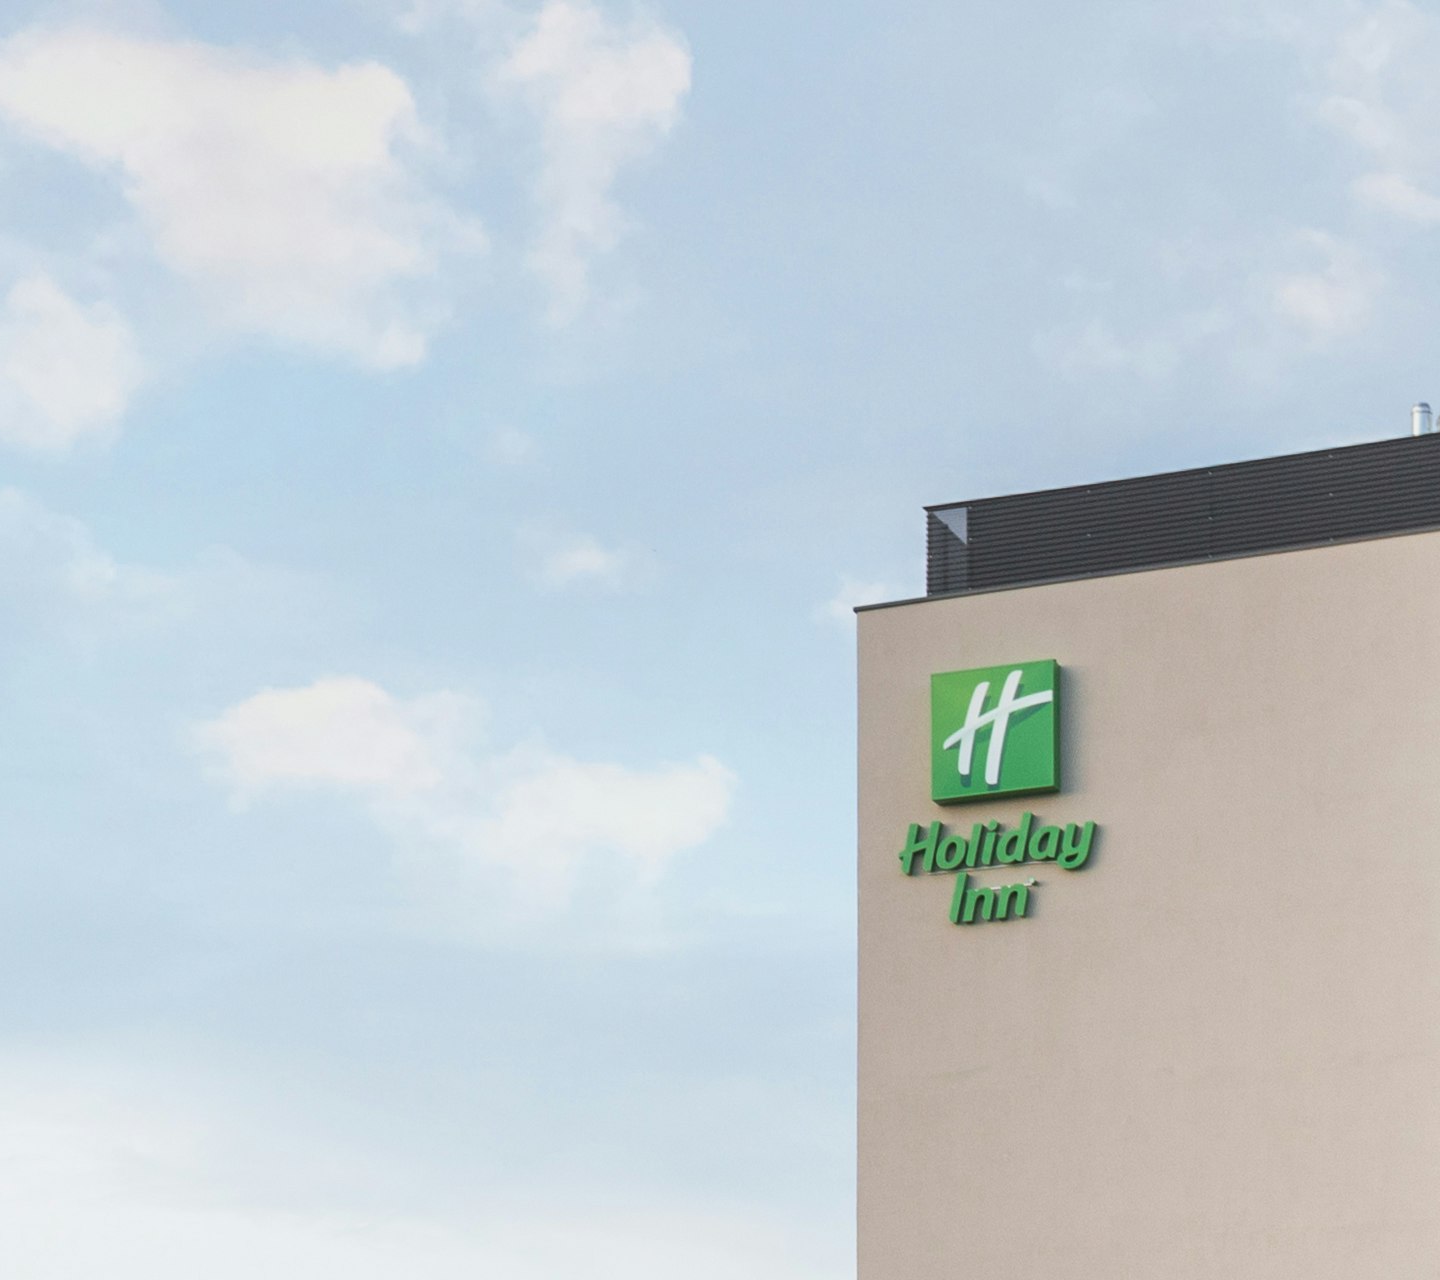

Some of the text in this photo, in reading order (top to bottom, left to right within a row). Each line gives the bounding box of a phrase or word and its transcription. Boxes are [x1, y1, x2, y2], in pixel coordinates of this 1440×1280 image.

[943, 669, 1053, 786] H
[899, 811, 1097, 877] Holiday
[949, 871, 1030, 925] Inn
